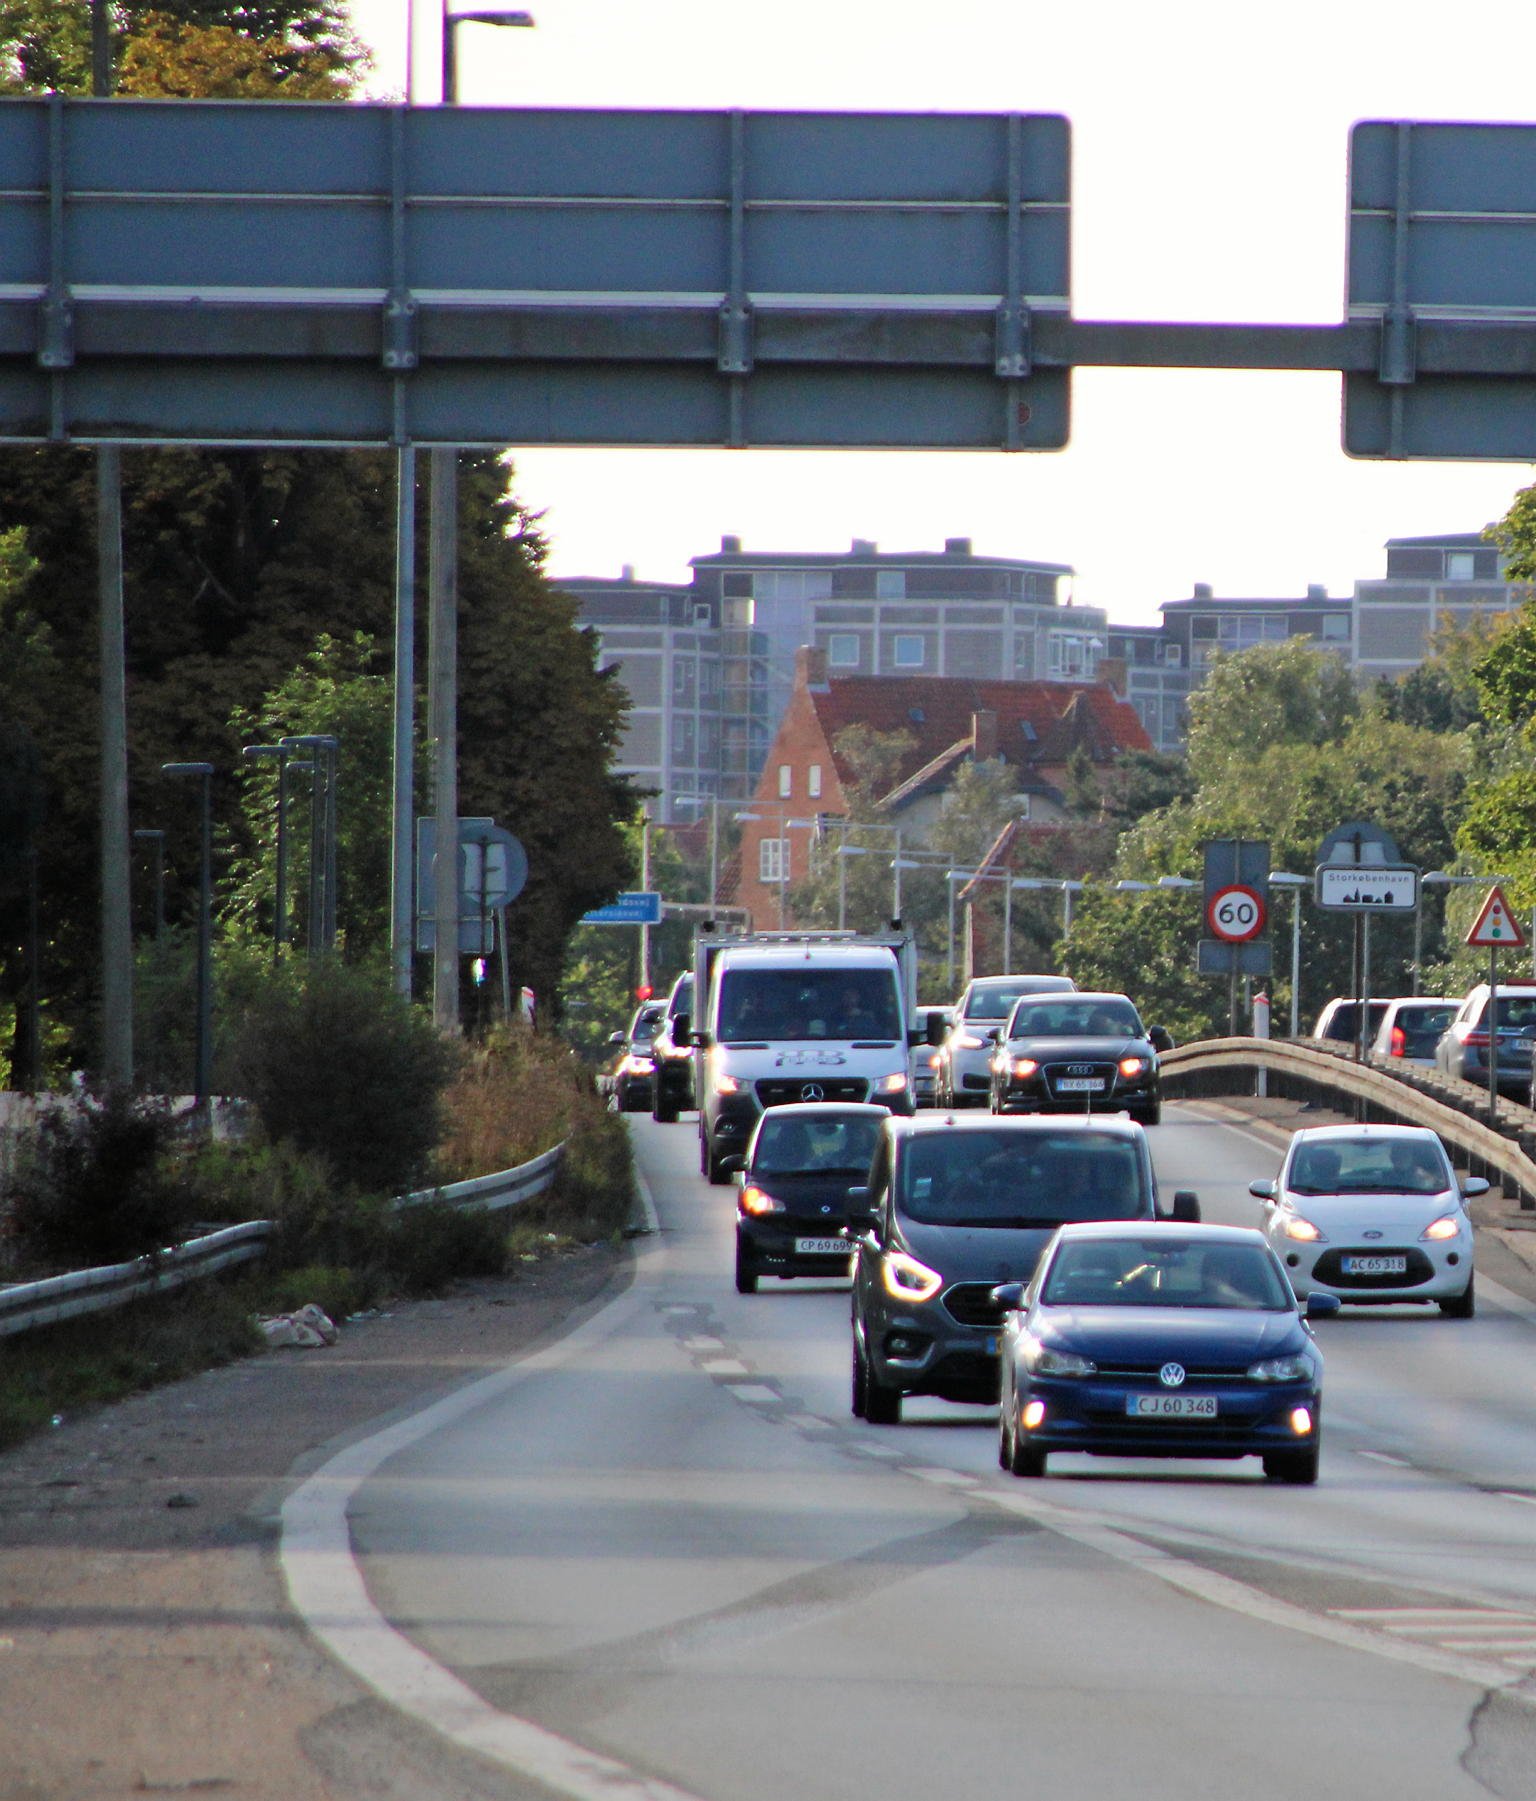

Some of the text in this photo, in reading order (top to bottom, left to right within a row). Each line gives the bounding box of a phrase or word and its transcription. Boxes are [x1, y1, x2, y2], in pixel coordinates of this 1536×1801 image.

[1329, 872, 1409, 882] Storkøbenhavn
[1219, 902, 1254, 924] 60
[801, 1241, 815, 1250] CP
[818, 1241, 831, 1250] 69
[1351, 1259, 1365, 1270] AC
[1368, 1259, 1381, 1270] 65
[1139, 1398, 1215, 1414] CJ 60 348
